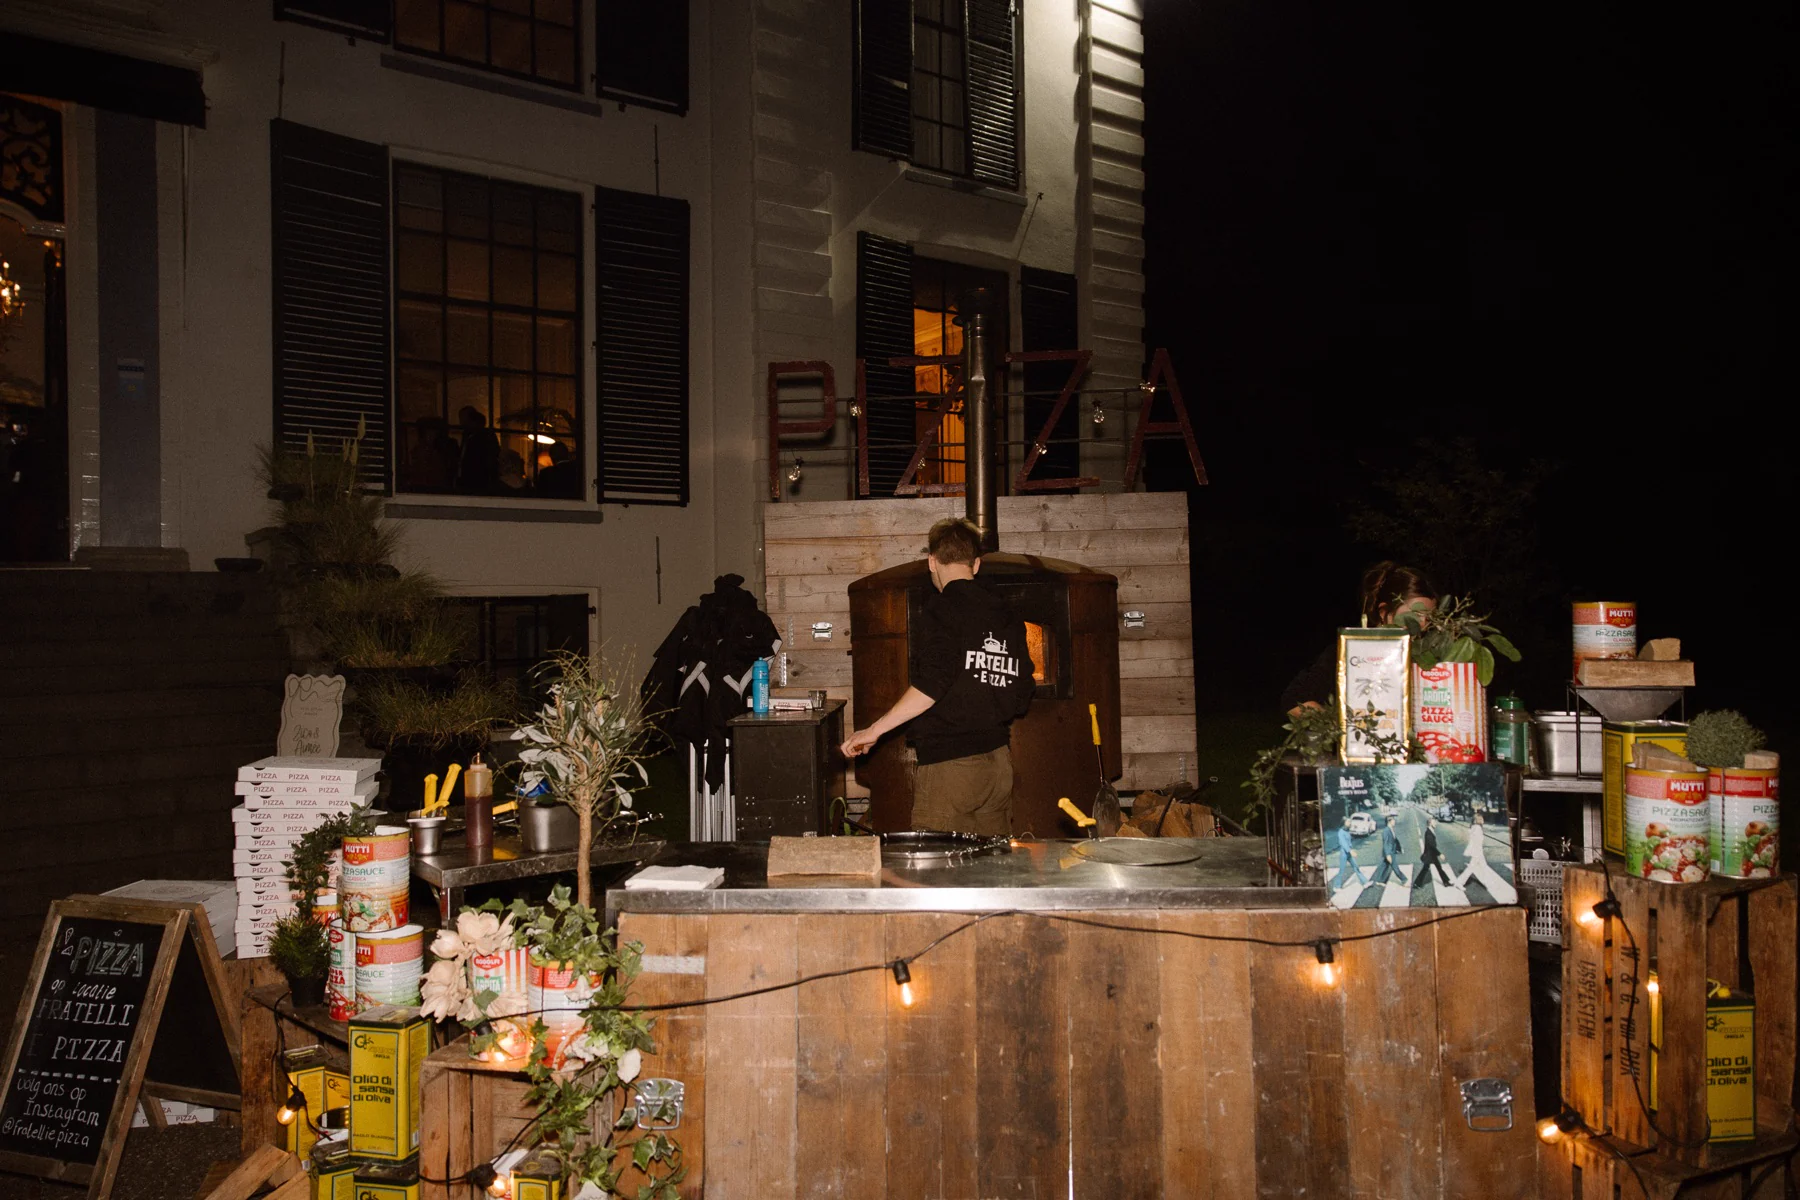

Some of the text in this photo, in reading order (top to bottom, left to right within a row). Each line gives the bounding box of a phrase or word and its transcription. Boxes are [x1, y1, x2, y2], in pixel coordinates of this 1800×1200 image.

[768, 347, 1208, 499] PIZZA
[980, 670, 988, 682] E
[1421, 706, 1454, 715] PIZZA
[1422, 715, 1454, 723] SAUCE
[1670, 782, 1705, 792] MUTTI
[345, 844, 370, 854] MUTTI
[69, 936, 144, 978] PIZZA
[1620, 972, 1640, 985] &
[51, 979, 66, 995] op
[36, 998, 134, 1027] FRATELLI
[51, 1036, 126, 1063] PIZZA
[1735, 1056, 1748, 1066] di
[1711, 1067, 1751, 1076] sansa
[353, 1075, 392, 1086] olio di
[1718, 1077, 1747, 1086] oliva
[44, 1082, 65, 1097] ons
[70, 1087, 87, 1108] op
[359, 1086, 394, 1095] sansa
[366, 1094, 391, 1104] oliva
[23, 1100, 100, 1128] Instagram
